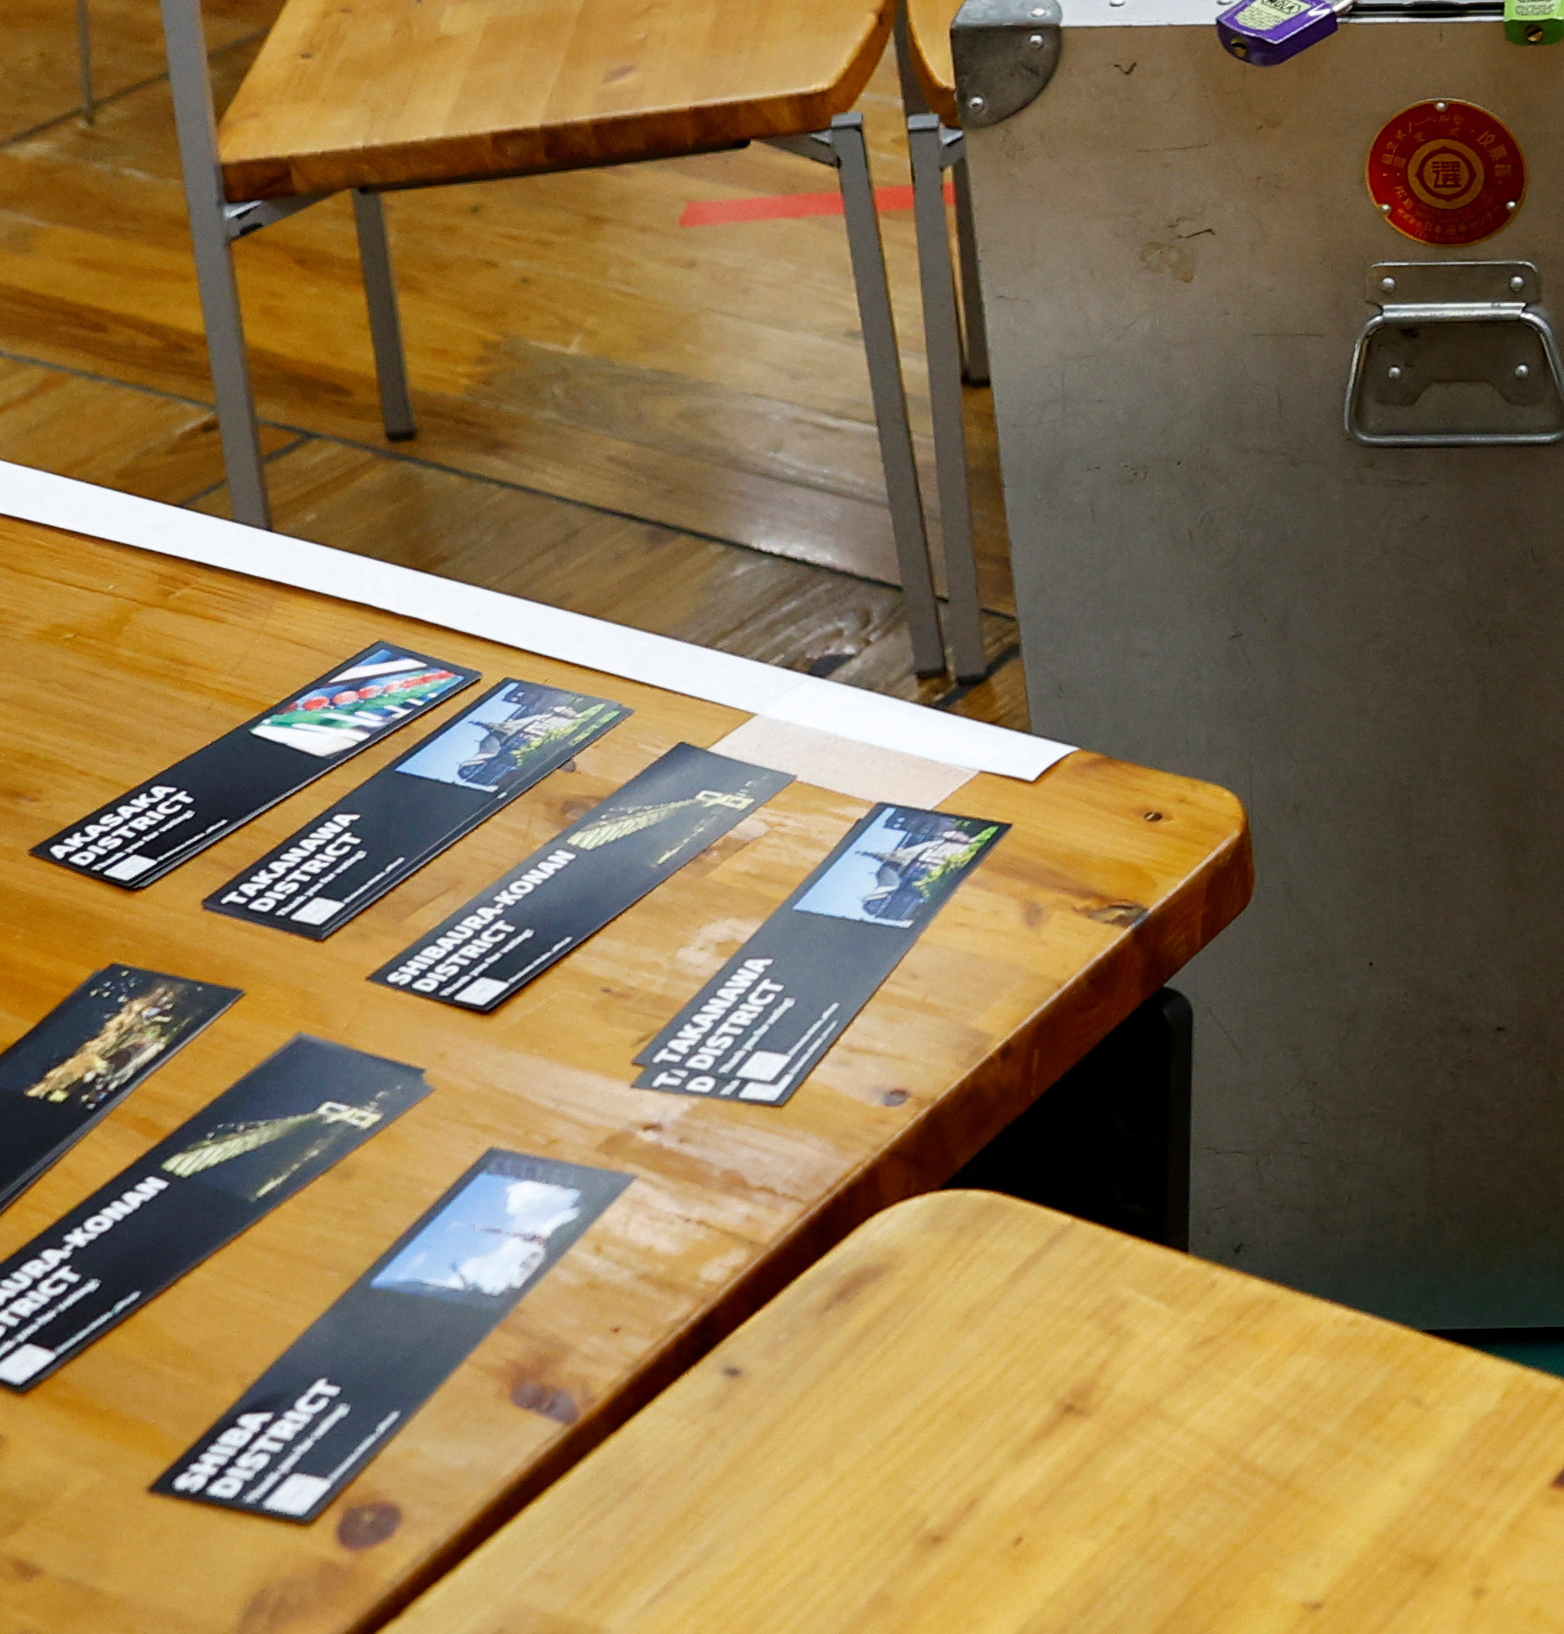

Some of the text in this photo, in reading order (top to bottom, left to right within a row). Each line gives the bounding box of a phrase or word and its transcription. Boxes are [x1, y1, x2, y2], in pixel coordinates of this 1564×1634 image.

[50, 785, 177, 859] AKASAKA
[69, 790, 195, 867] DISTRICT
[220, 812, 361, 905] TAKANAWA
[247, 832, 362, 912] DISTRICT
[387, 849, 577, 986] SHIBAURA-KONAN
[411, 920, 516, 993] DISTRICT
[651, 957, 775, 1064] TAKANAWA
[684, 978, 785, 1071] DISTRICT
[172, 1411, 274, 1493] SHIBA
[205, 1377, 342, 1499] DISTRICT
